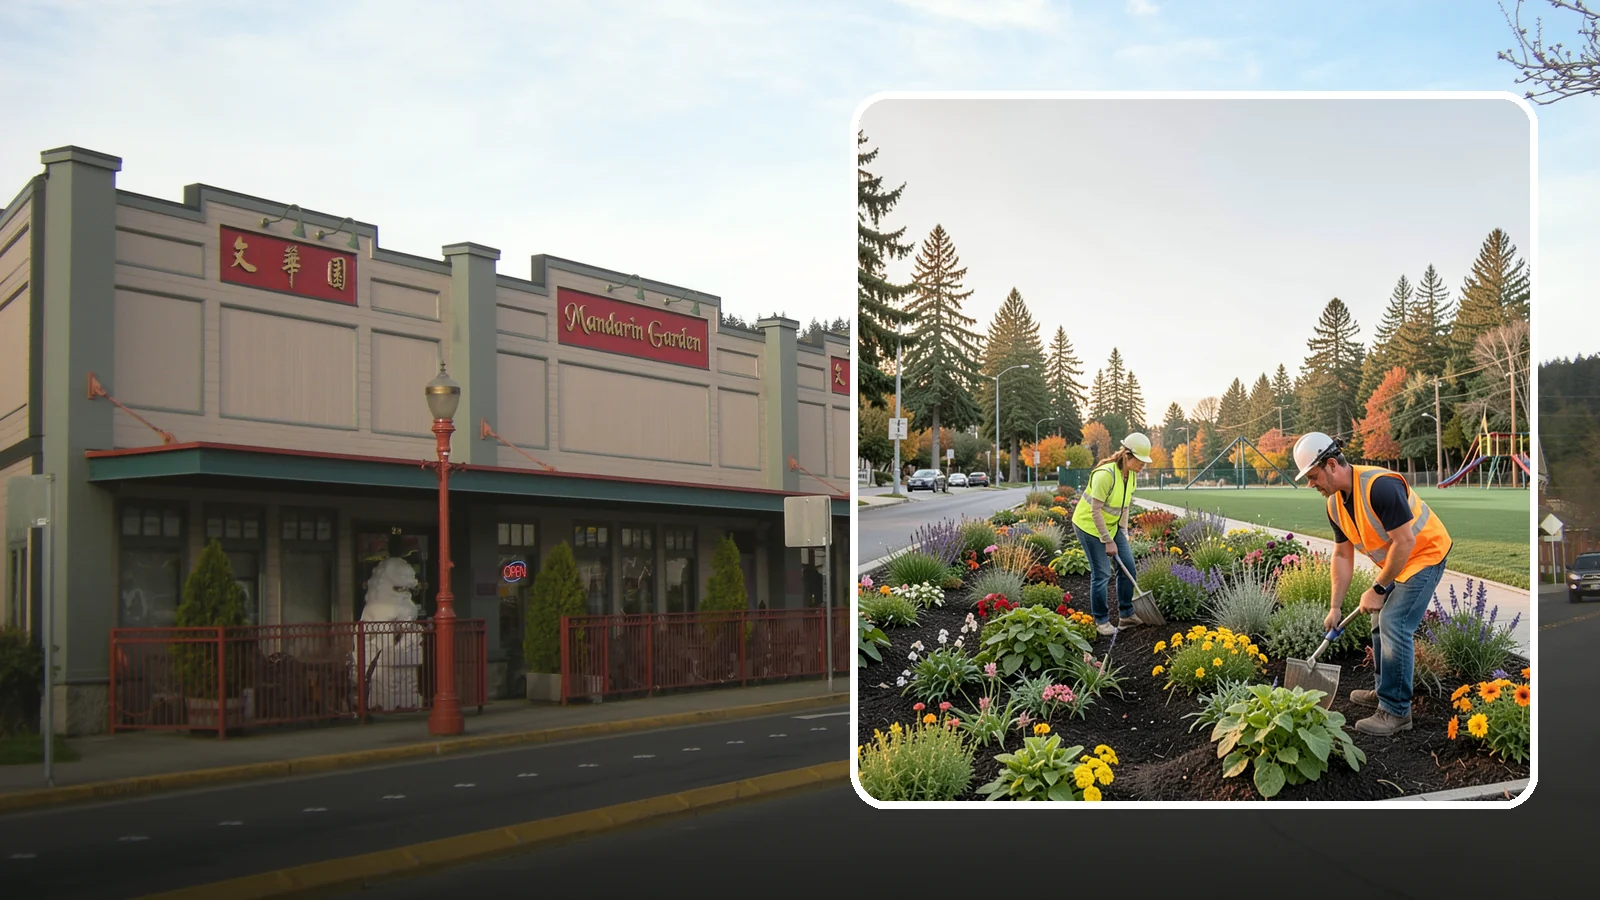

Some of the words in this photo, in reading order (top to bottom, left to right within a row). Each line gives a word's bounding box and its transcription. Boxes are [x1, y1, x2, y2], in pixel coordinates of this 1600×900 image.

[231, 236, 346, 291] 文華園
[565, 302, 644, 341] Mandarin
[648, 320, 701, 352] Garden
[503, 565, 527, 578] OPEN
